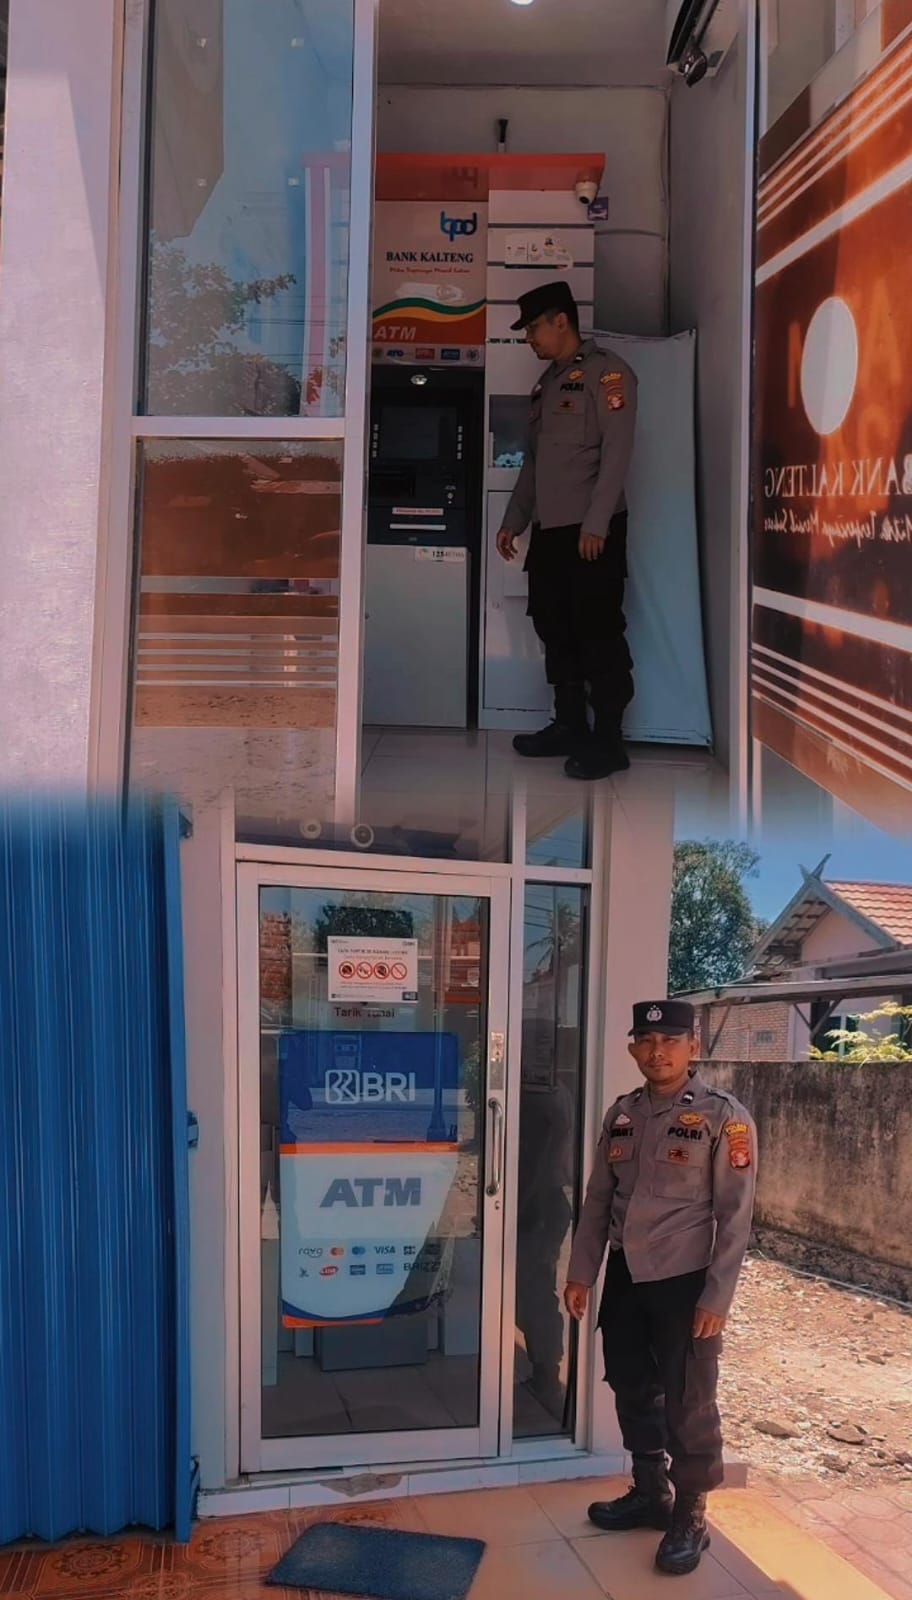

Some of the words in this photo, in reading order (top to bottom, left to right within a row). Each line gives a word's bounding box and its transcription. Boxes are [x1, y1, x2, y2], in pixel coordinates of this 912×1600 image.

[440, 211, 477, 241] bpd
[386, 251, 417, 262] BANK
[420, 252, 474, 263] KALTENG
[374, 325, 416, 340] ATM
[334, 1007, 361, 1017] Tarik
[363, 1072, 416, 1102] BRI
[667, 1127, 703, 1140] POLRI
[320, 1177, 422, 1208] ATM
[374, 1245, 396, 1254] VISA
